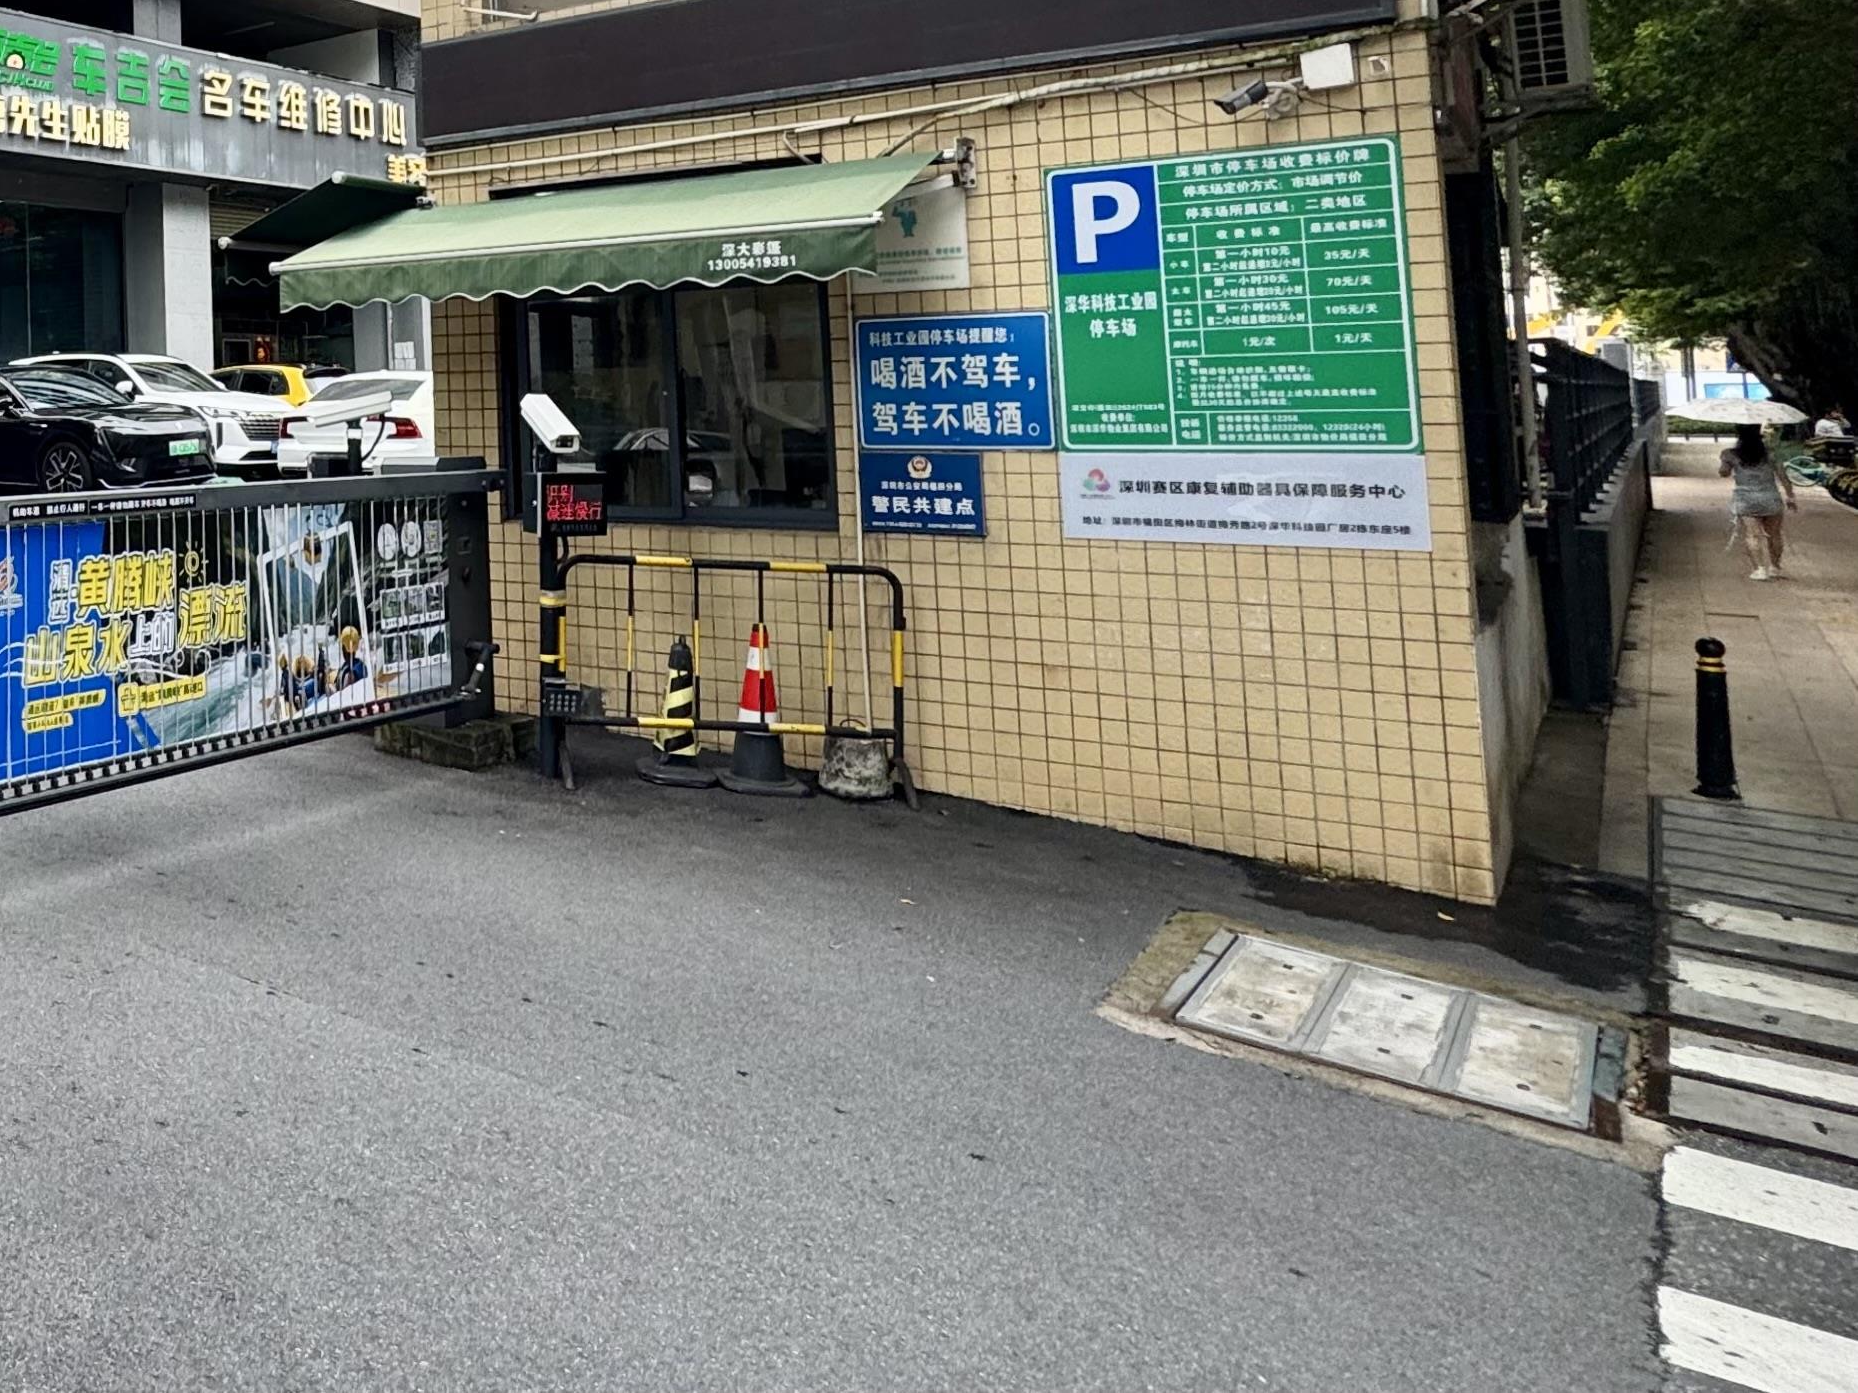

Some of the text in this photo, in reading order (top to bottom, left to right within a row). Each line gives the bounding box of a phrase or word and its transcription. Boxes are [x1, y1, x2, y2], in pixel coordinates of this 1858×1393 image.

[1175, 148, 1370, 178] 深圳市停车场收费标价牌
[1072, 181, 1141, 263] P
[1065, 291, 1158, 314] 深华科技工业园
[1089, 318, 1137, 338] 停车场
[1119, 480, 1406, 499] 深圳赛区康复辅助器具保障服务中心
[871, 496, 975, 516] 警民共建点
[77, 549, 174, 618] 黄腾峡
